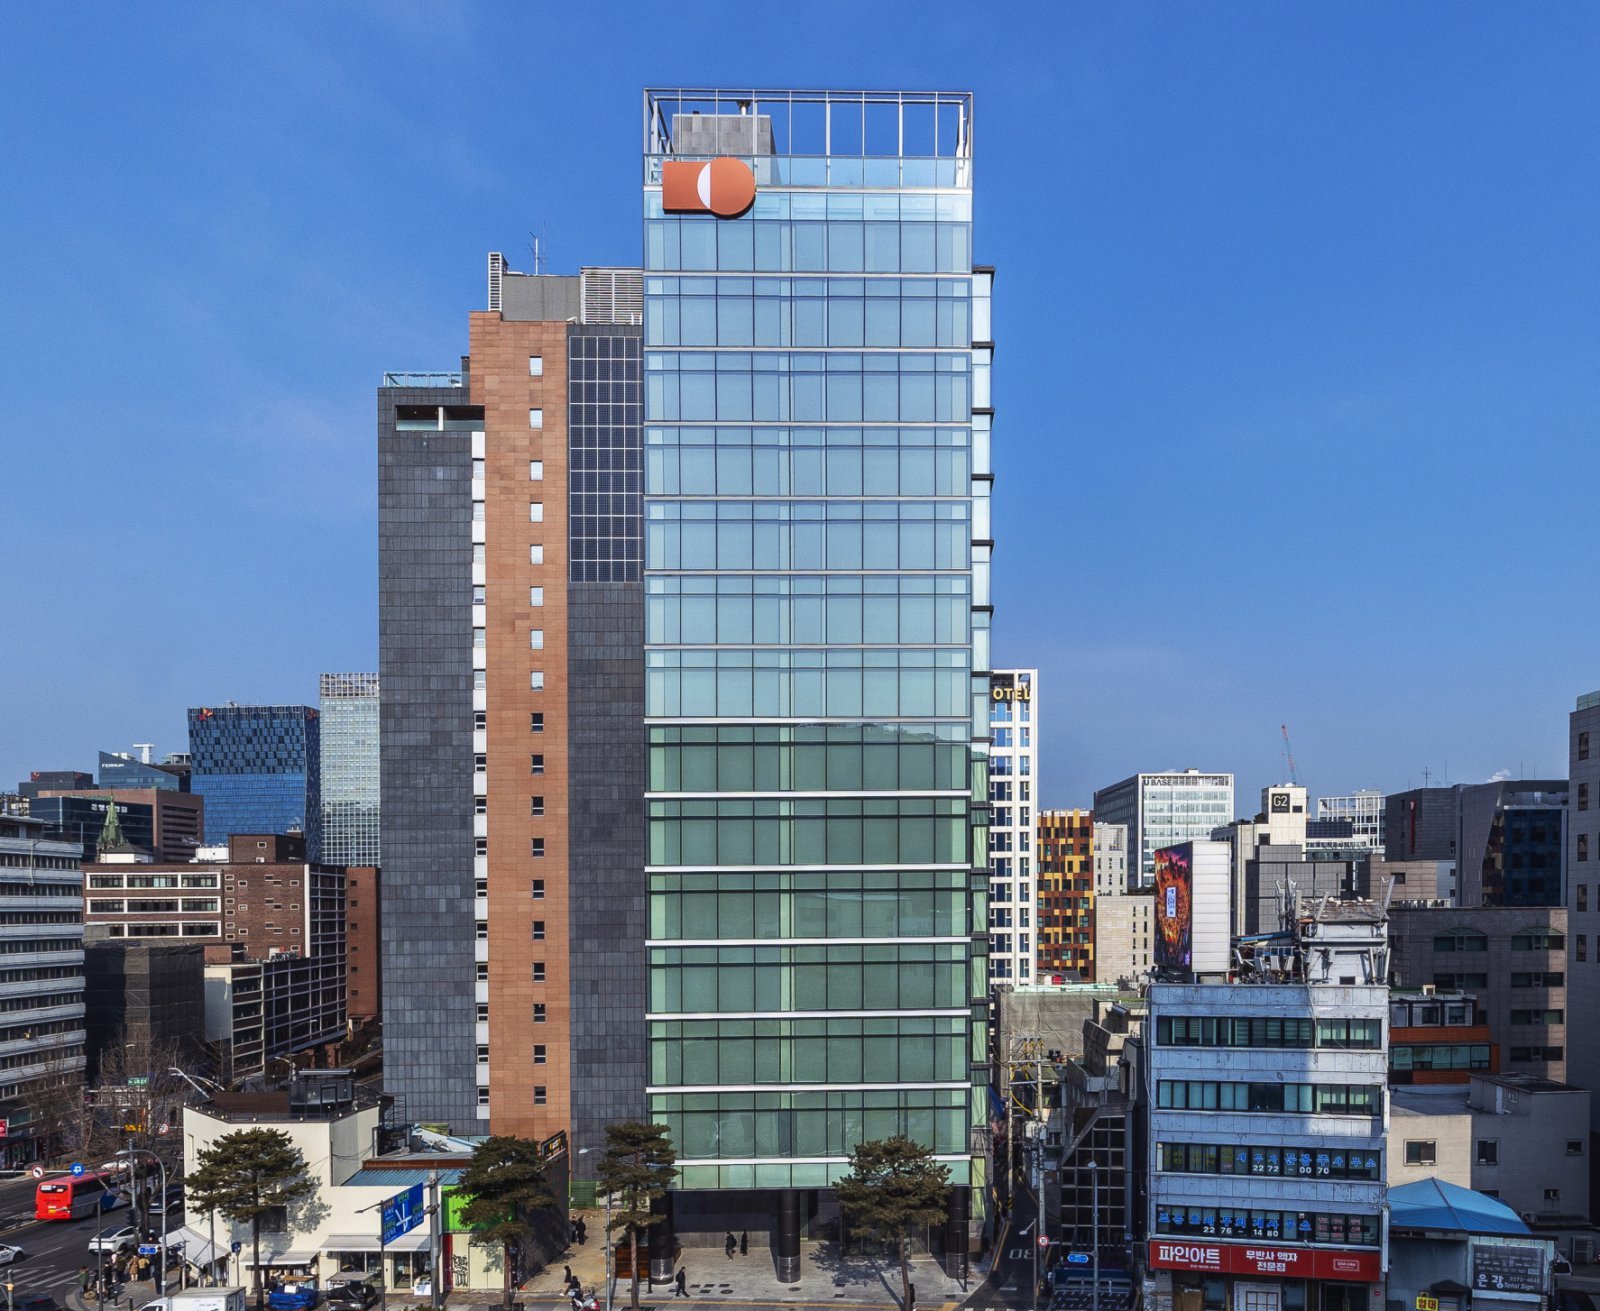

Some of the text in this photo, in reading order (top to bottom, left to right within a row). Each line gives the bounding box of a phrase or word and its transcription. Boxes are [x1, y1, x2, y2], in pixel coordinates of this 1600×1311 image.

[1273, 795, 1288, 807] G2
[1158, 1245, 1220, 1264] 파인아트
[1245, 1249, 1297, 1262] 무반사 액자
[1256, 1261, 1286, 1272] 전문점
